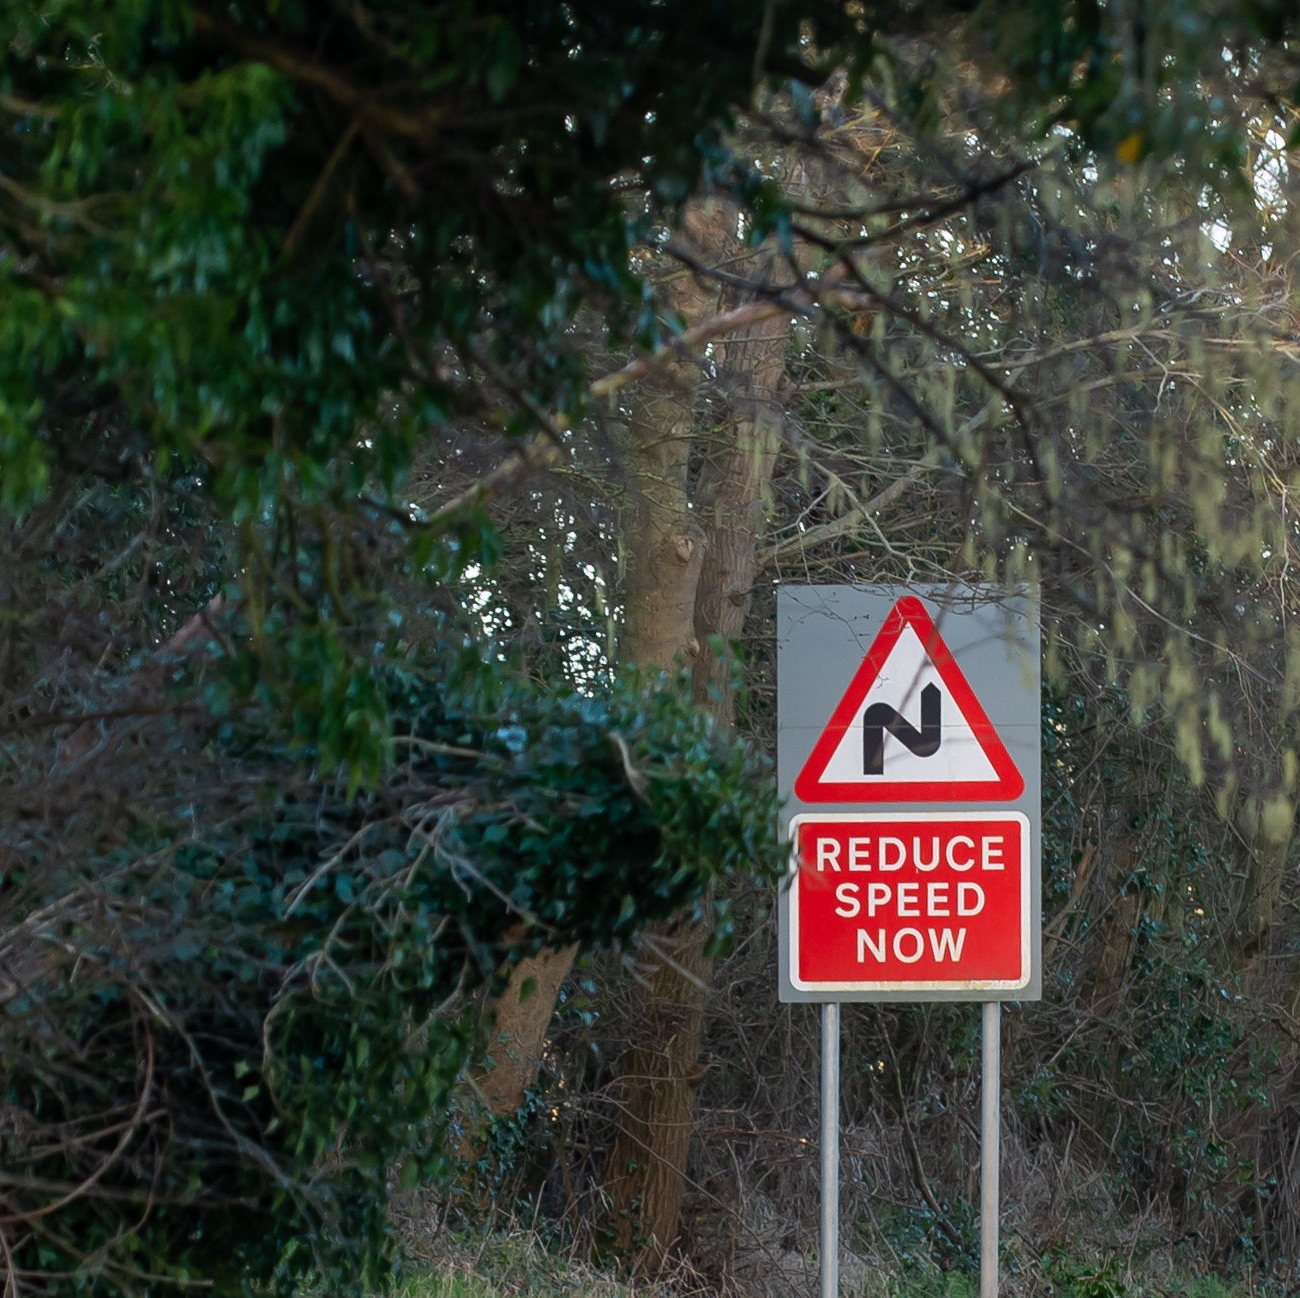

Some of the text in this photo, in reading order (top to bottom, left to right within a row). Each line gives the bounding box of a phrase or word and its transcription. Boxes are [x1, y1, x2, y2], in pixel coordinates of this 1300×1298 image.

[816, 835, 1005, 872] REDUCE
[834, 882, 986, 918] SPEED
[856, 927, 967, 964] NOW
